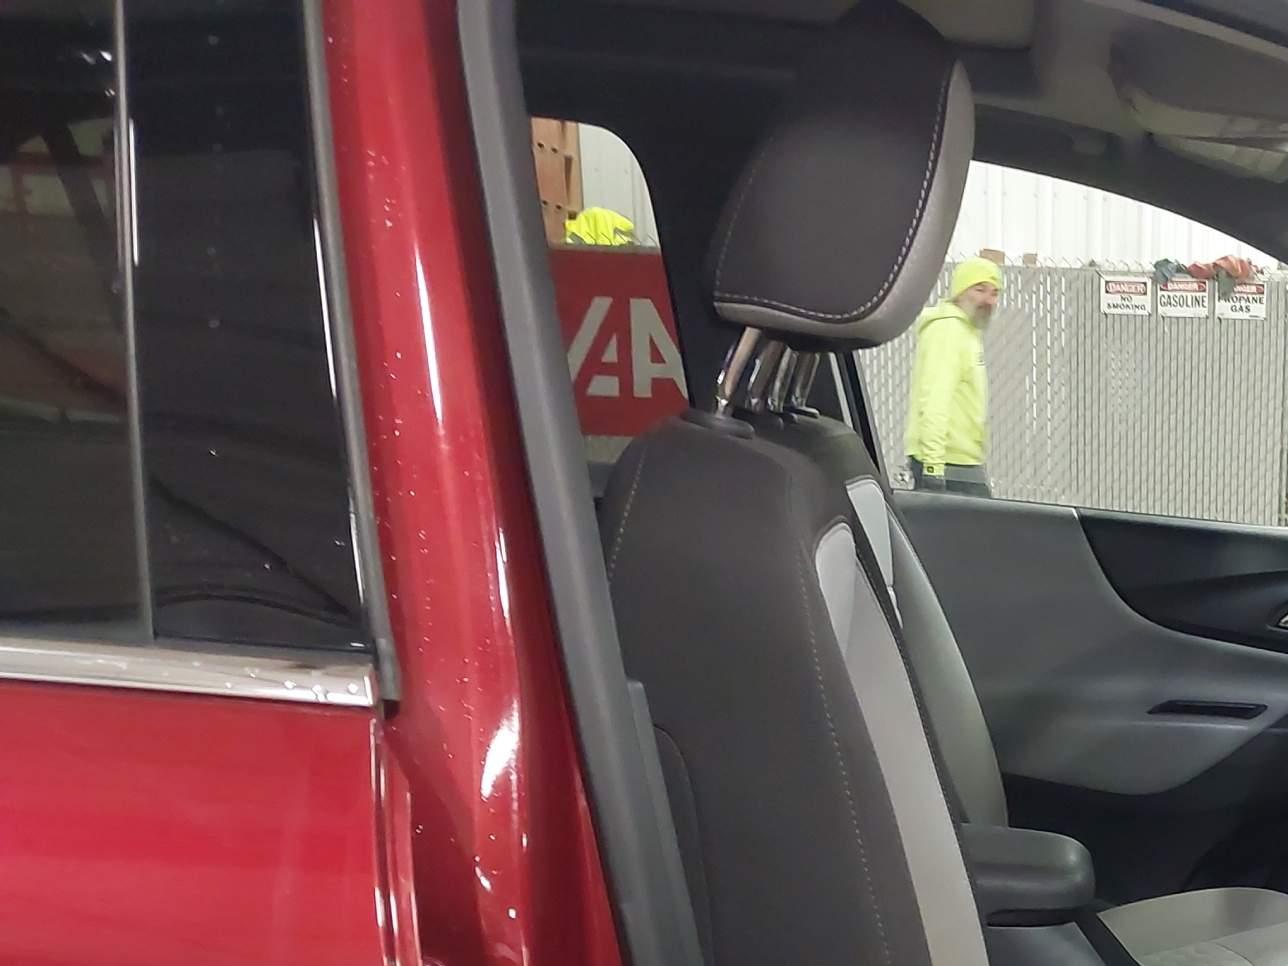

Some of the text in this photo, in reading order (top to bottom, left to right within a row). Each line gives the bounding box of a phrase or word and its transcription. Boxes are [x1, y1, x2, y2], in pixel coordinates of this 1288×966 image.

[1120, 295, 1133, 303] NO
[1160, 294, 1207, 308] GASOLINE
[1107, 303, 1146, 312] SMOKING
[1231, 304, 1251, 313] GAS
